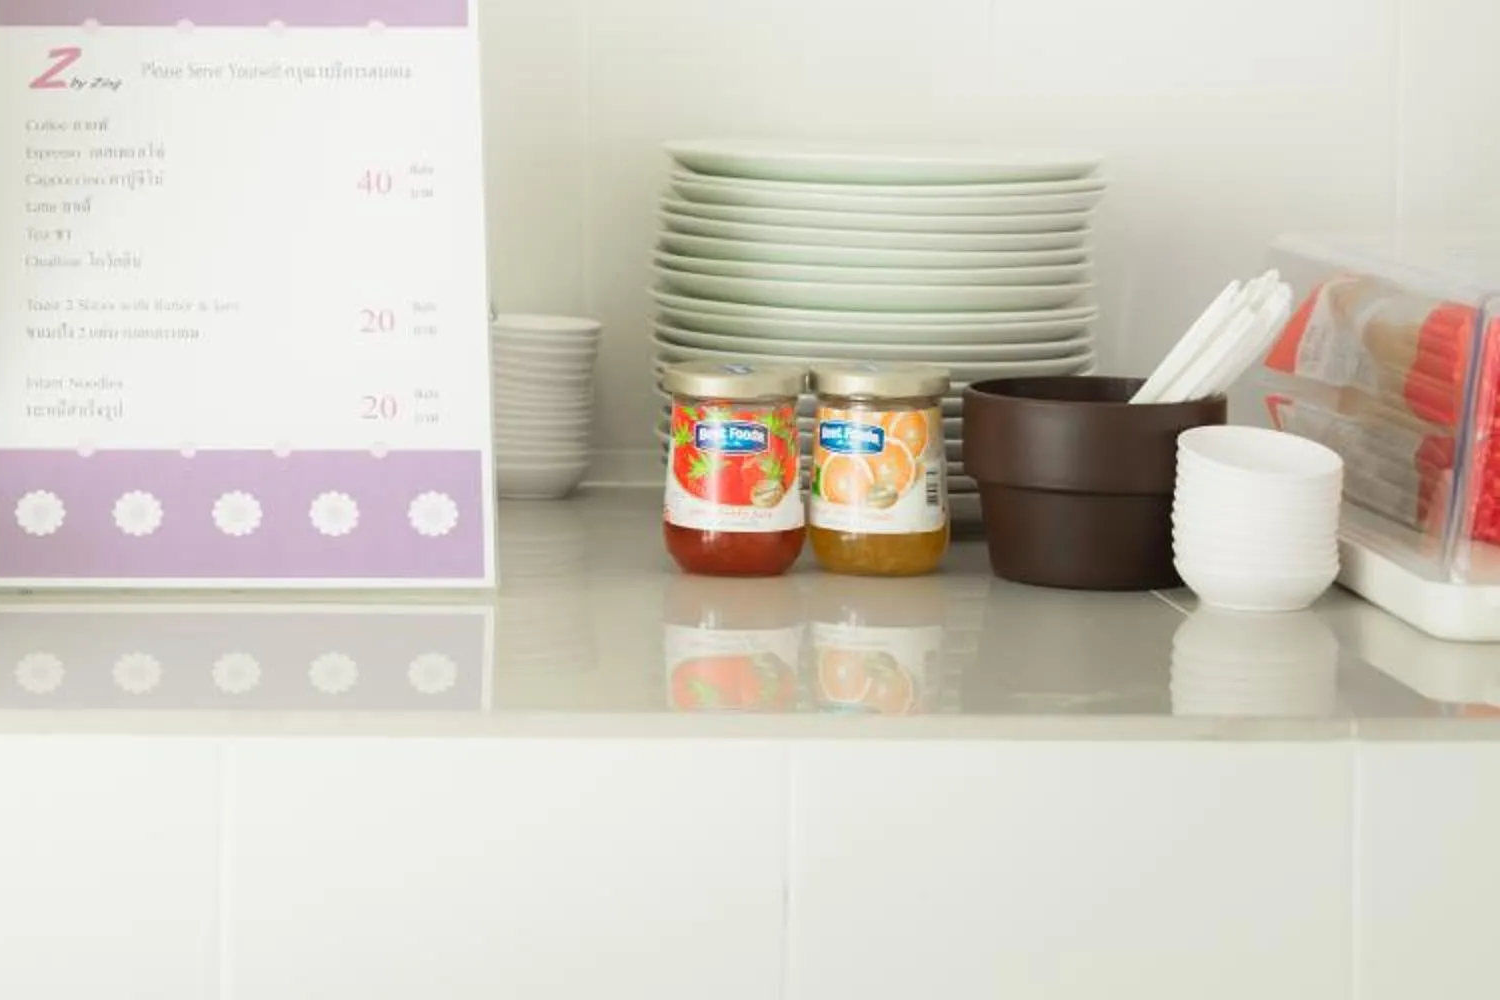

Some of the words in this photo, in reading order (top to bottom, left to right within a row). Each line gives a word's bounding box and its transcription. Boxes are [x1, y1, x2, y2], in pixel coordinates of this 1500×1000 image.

[28, 47, 83, 89] Z
[141, 61, 184, 79] Please
[357, 169, 392, 195] 40
[359, 308, 396, 334] 20
[361, 394, 398, 420] 20
[699, 427, 726, 441] Bet
